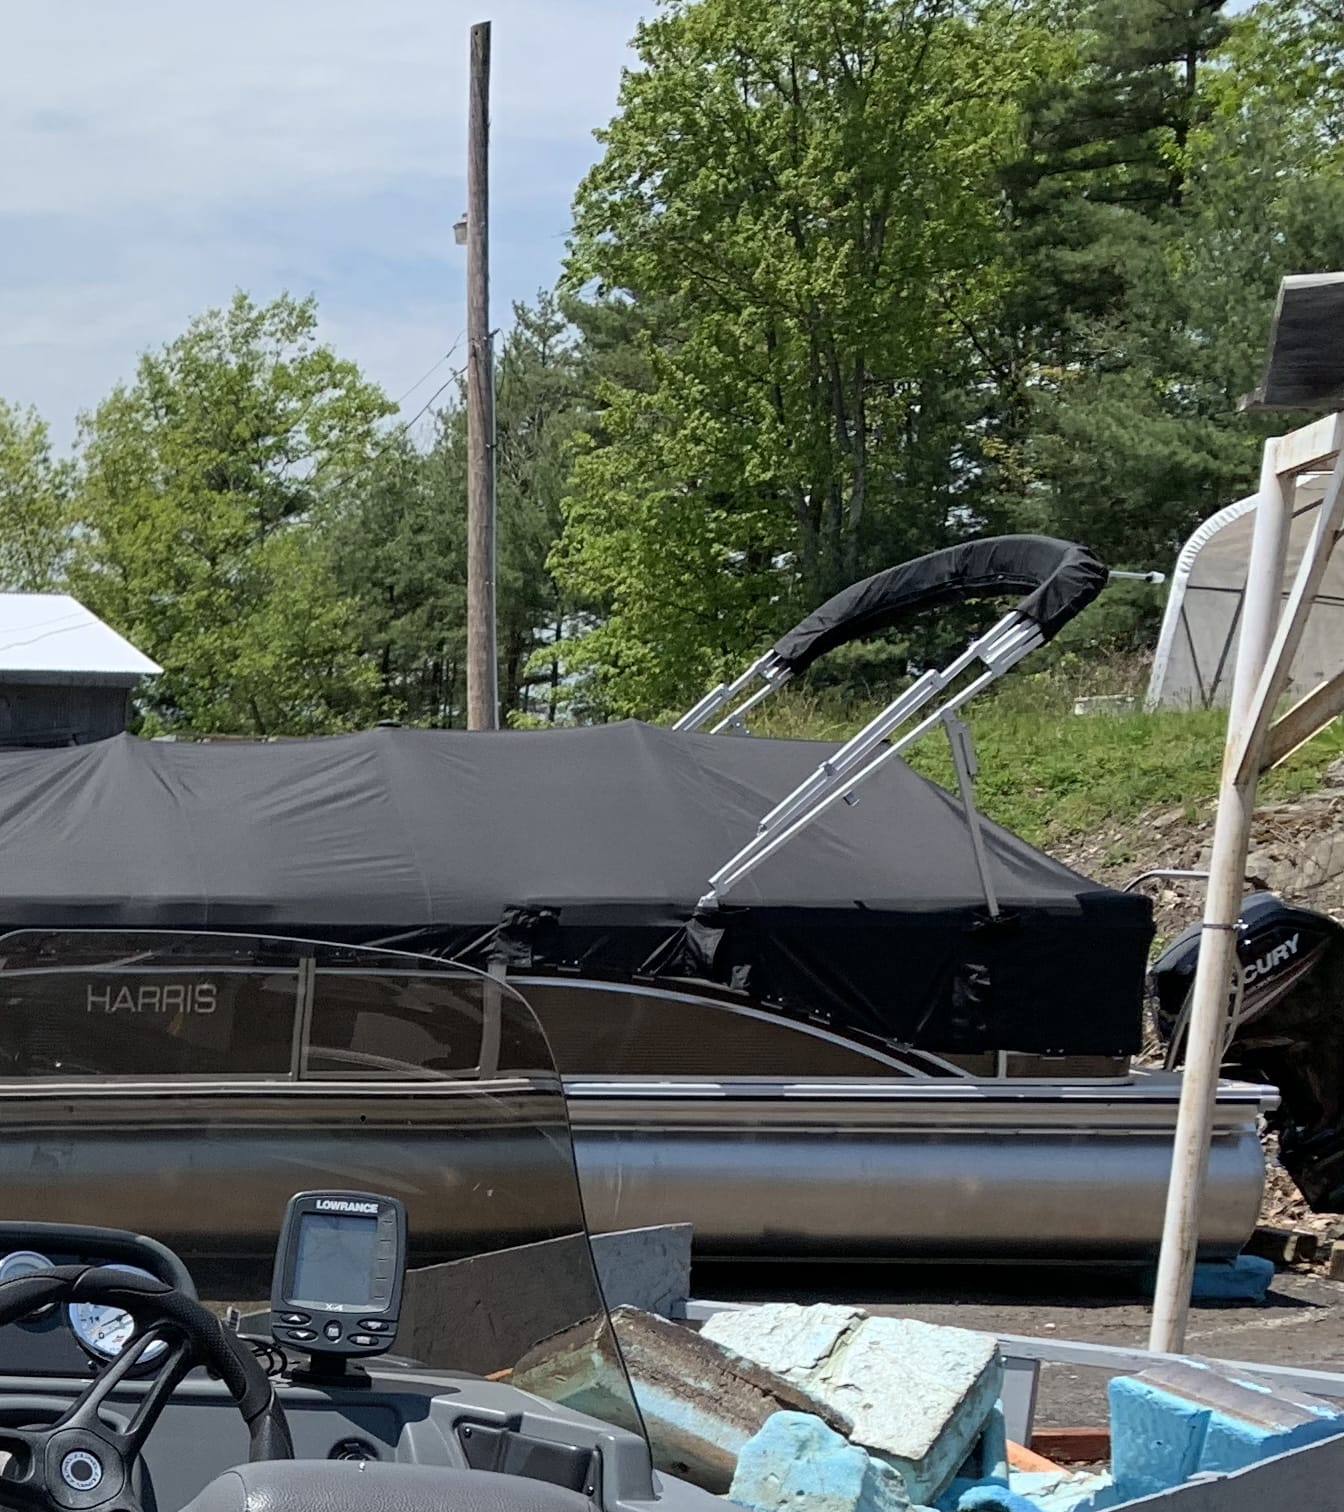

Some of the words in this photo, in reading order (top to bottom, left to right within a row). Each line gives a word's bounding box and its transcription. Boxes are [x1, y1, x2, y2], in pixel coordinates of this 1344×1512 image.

[1241, 932, 1299, 984] CURY
[87, 984, 217, 1013] HARRIS
[316, 1199, 379, 1213] LOWRANCE
